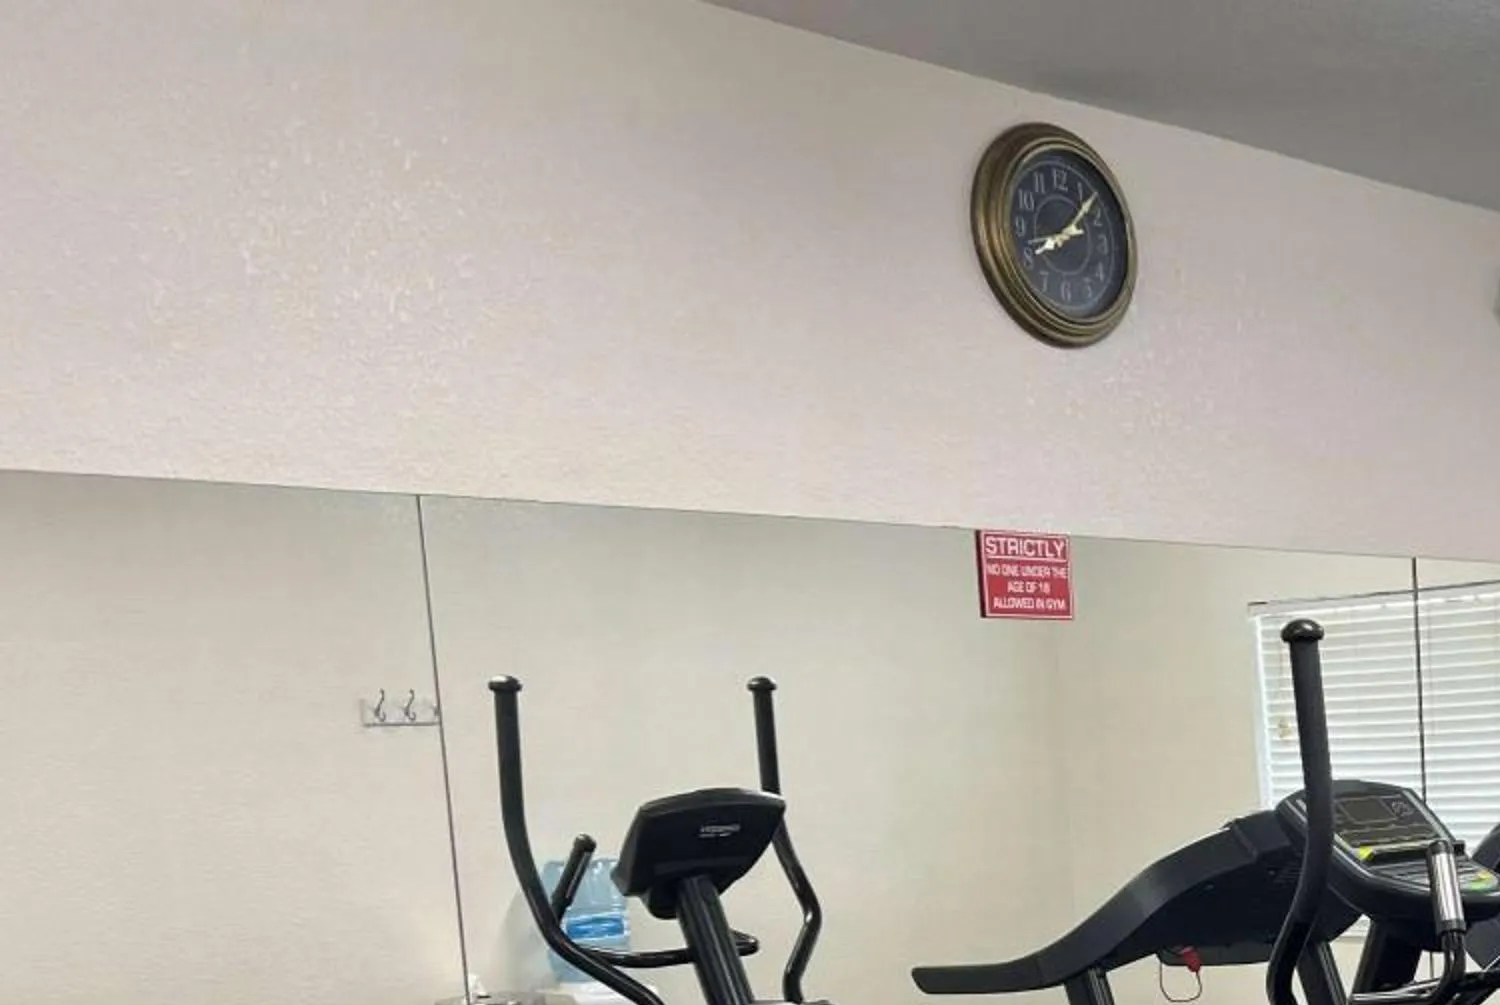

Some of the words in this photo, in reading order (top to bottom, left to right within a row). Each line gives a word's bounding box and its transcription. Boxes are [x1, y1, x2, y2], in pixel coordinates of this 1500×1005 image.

[1033, 171, 1046, 194] 11
[1052, 168, 1068, 191] 12
[1018, 188, 1035, 212] 10
[985, 536, 1065, 557] STRICTLY
[987, 563, 1001, 576] NO
[1002, 564, 1020, 577] ONE
[1022, 565, 1051, 578] UNDER
[1007, 581, 1025, 593] AGE
[1026, 581, 1037, 593] OF
[993, 597, 1035, 609] ALLOWED
[1036, 597, 1045, 609] IN
[1046, 598, 1066, 610] GYM
